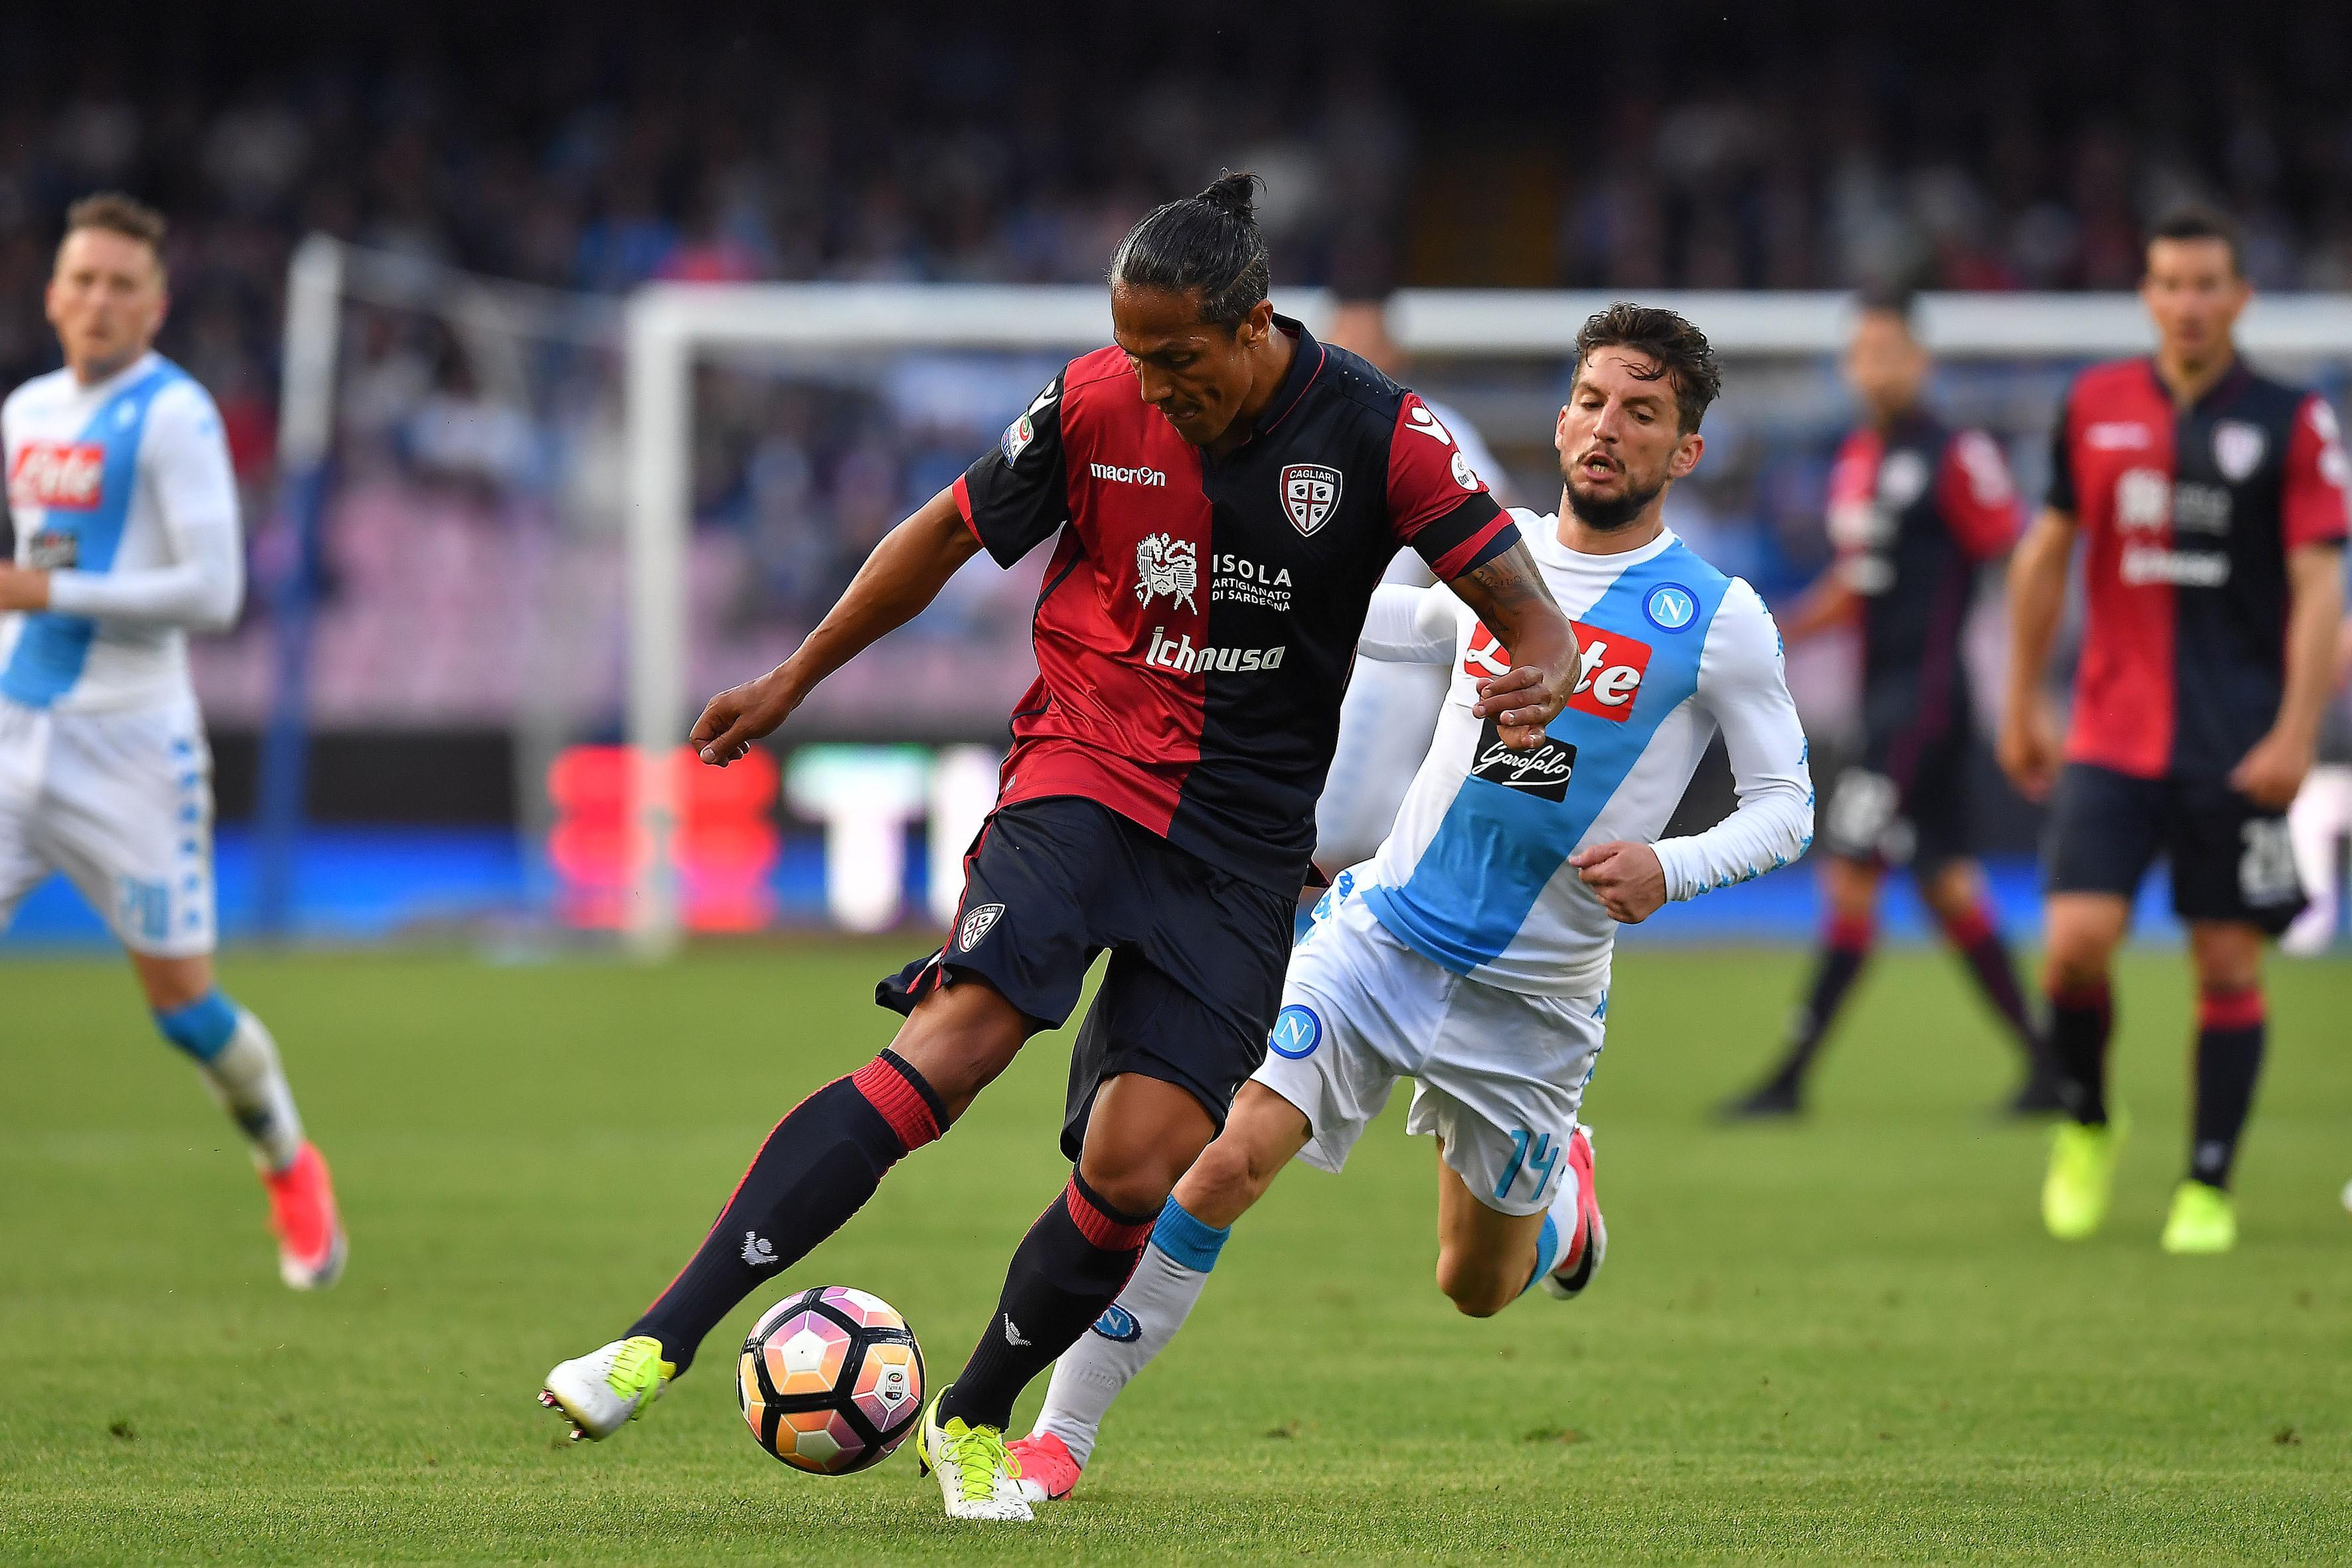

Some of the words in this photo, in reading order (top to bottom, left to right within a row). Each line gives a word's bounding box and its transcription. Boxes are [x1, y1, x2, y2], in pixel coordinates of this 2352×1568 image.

[1090, 463, 1166, 487] macron
[1289, 469, 1334, 483] CAGLIARI
[1212, 554, 1292, 587] ISOLA
[1212, 578, 1291, 601] ARTIGIANATO
[1212, 590, 1223, 601] DI
[1228, 590, 1291, 611] SARDEGNA
[1657, 593, 1686, 621] N
[1145, 626, 1286, 674] ichnusa
[1465, 637, 1641, 706] Lte
[1471, 740, 1572, 786] Garofalo
[966, 906, 998, 921] CAGLIARI
[1278, 1016, 1310, 1046] N
[1494, 1129, 1559, 1201] 14
